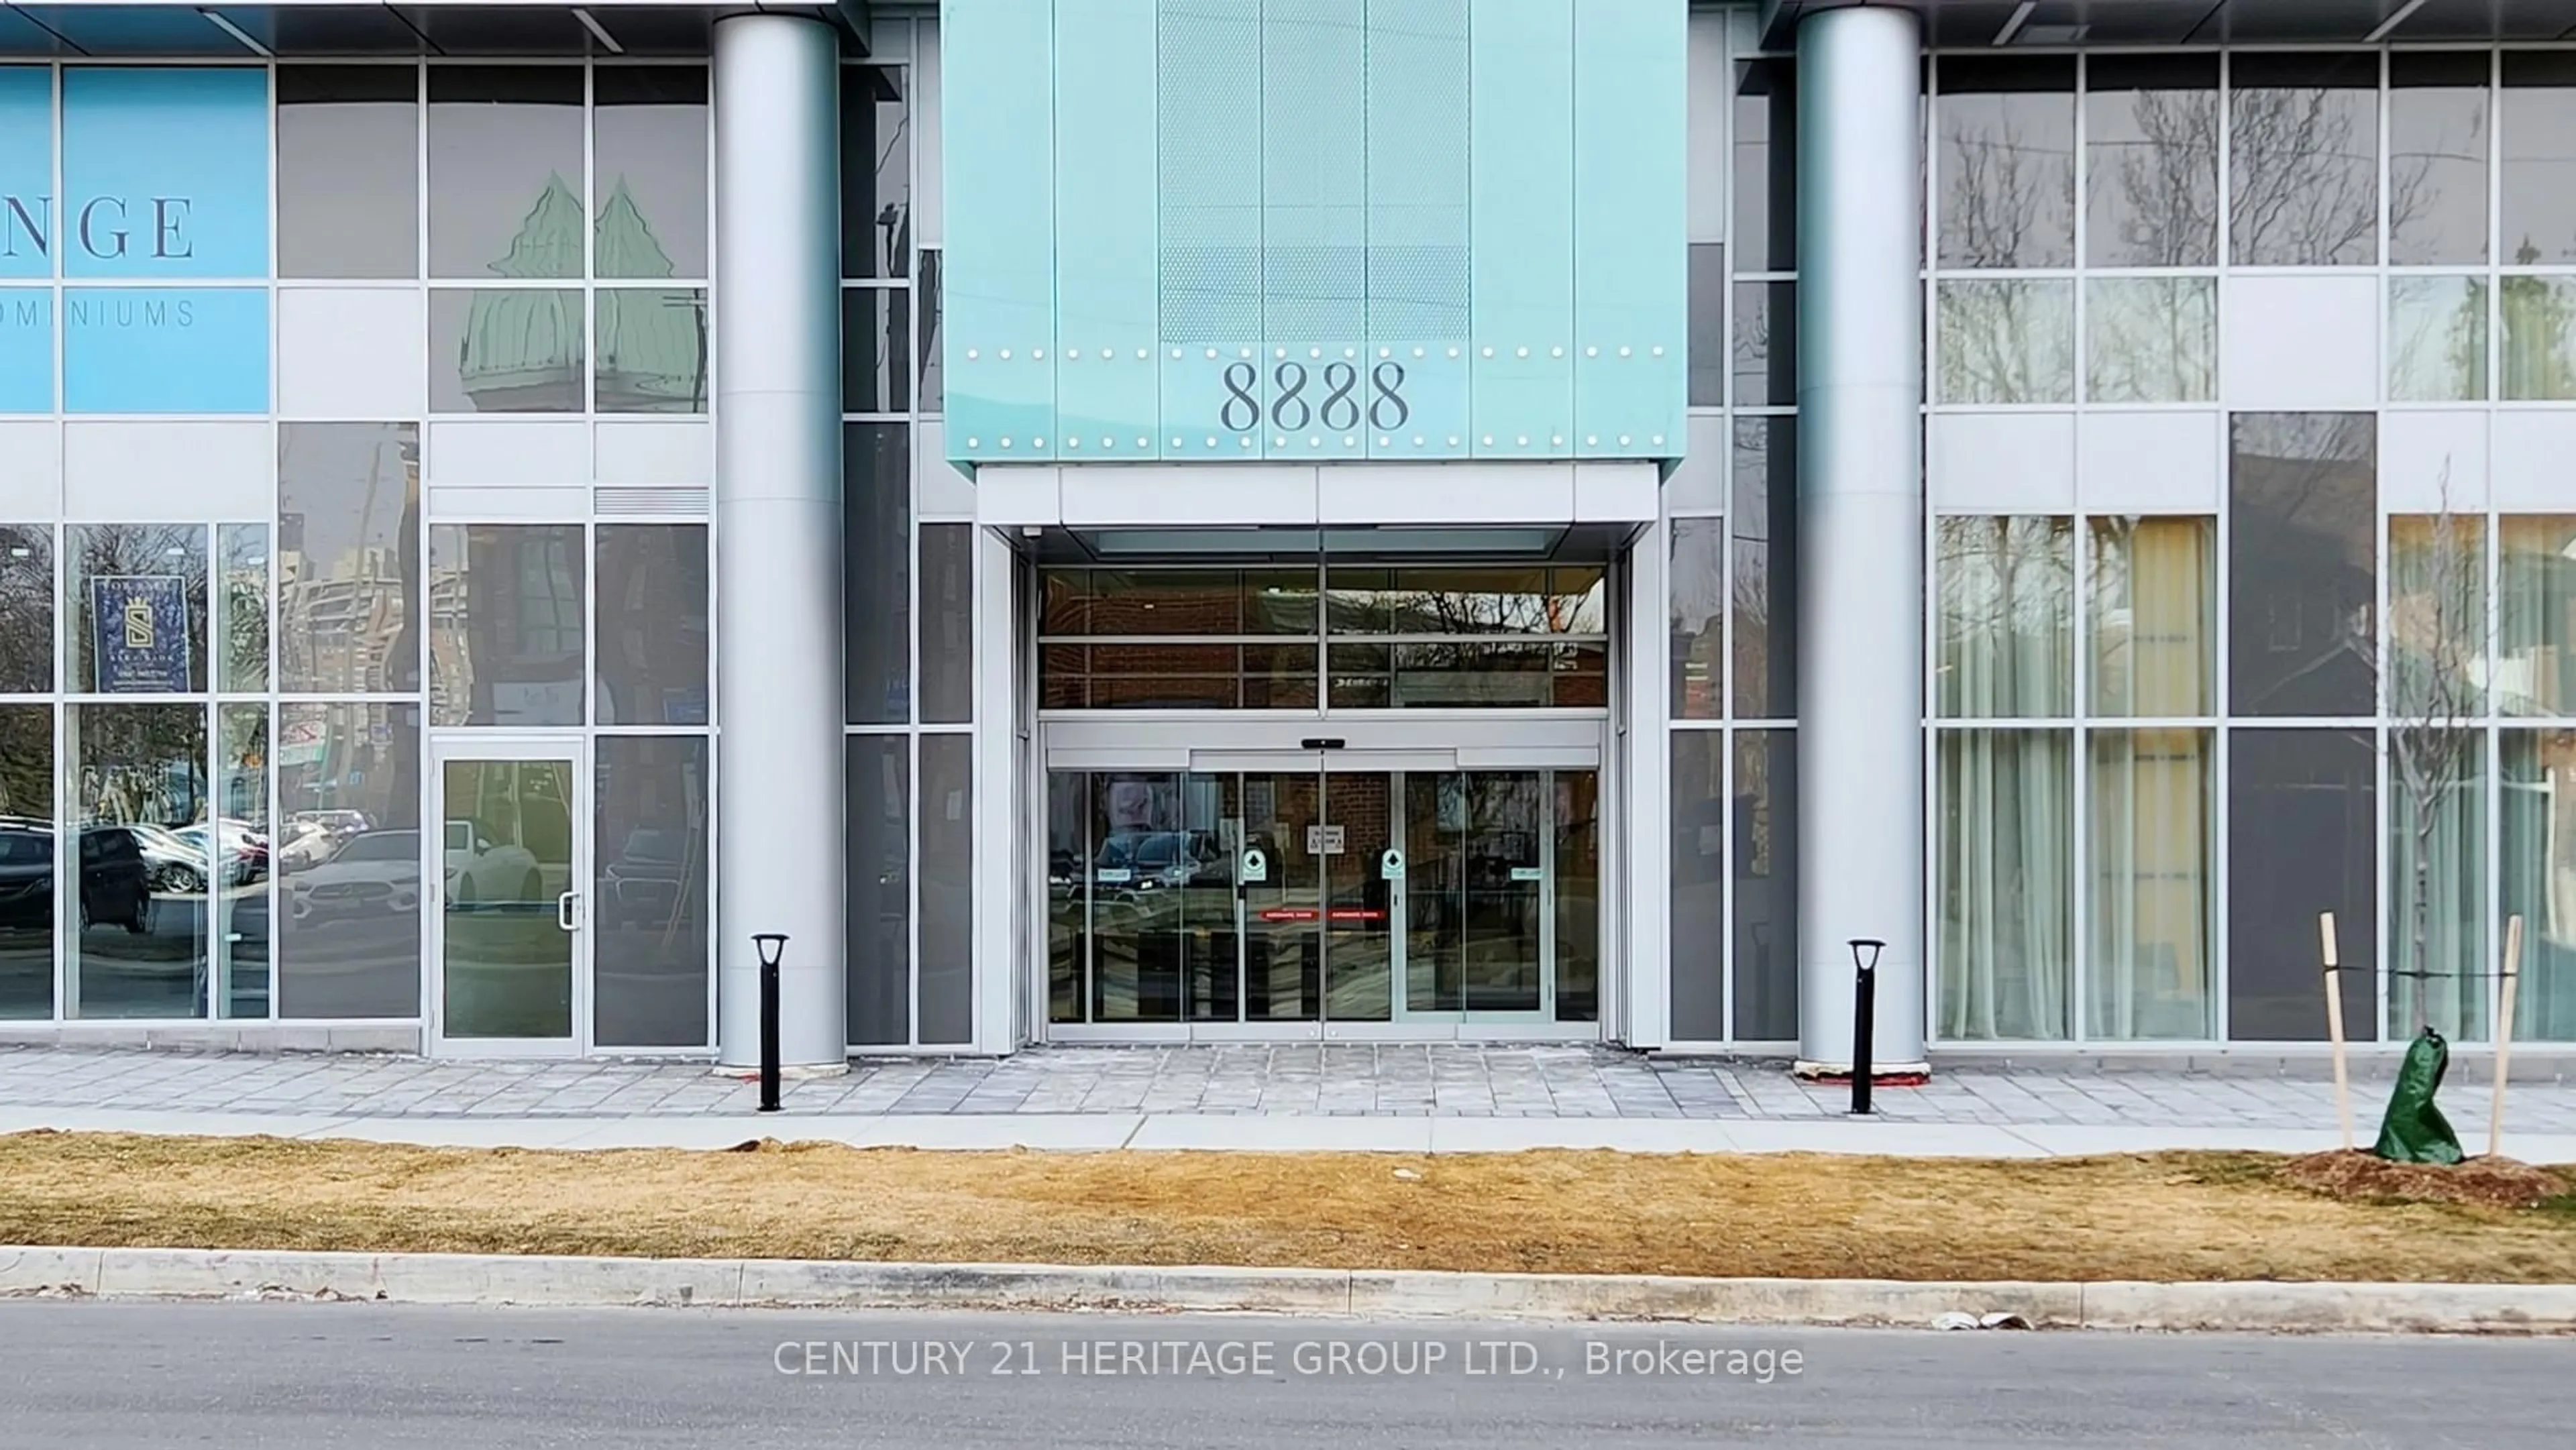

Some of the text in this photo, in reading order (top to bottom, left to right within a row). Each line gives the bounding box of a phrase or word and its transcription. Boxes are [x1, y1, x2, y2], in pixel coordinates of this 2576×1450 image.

[2, 196, 193, 259] NGE
[0, 300, 193, 327] MINIUMS
[1220, 361, 1408, 431] 8888
